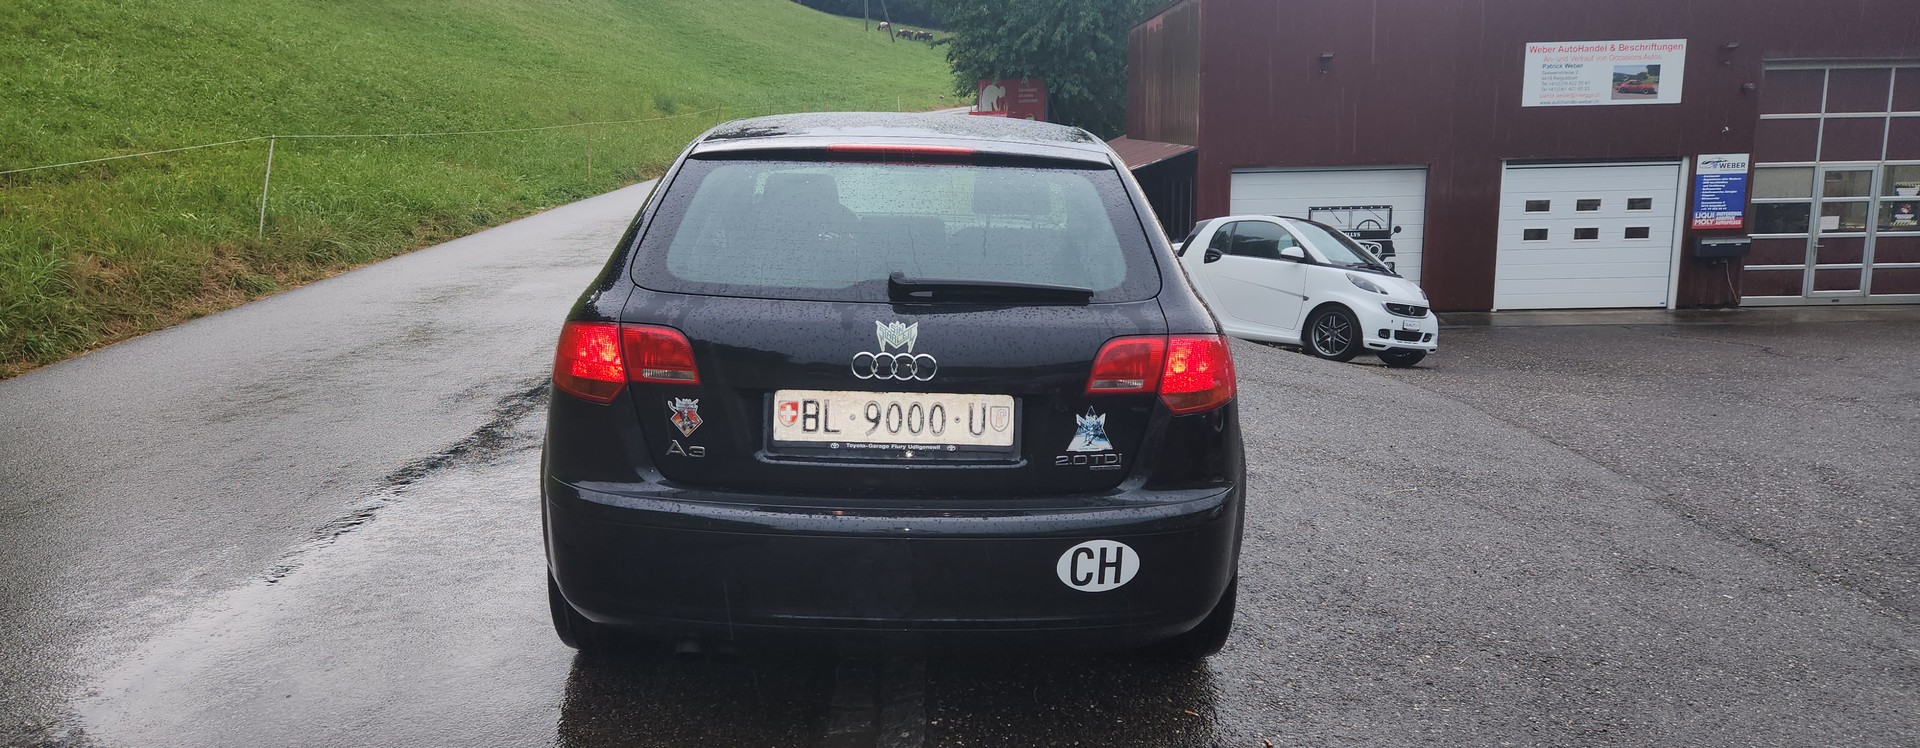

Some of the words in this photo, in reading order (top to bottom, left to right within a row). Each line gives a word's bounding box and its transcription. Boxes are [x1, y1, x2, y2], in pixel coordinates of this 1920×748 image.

[1529, 45, 1556, 54] Weber
[1558, 43, 1607, 53] AutoHandel
[1610, 43, 1616, 51] &
[1619, 42, 1684, 53] Beschriftungen
[1643, 53, 1661, 61] Autos
[890, 323, 905, 335] SIN
[802, 398, 841, 434] BL
[864, 400, 947, 437] 9000
[968, 402, 987, 438] U
[665, 439, 706, 458] A3
[846, 442, 890, 450] Toyota-Garage
[1055, 454, 1088, 466] 2.0
[1070, 546, 1123, 586] CH
